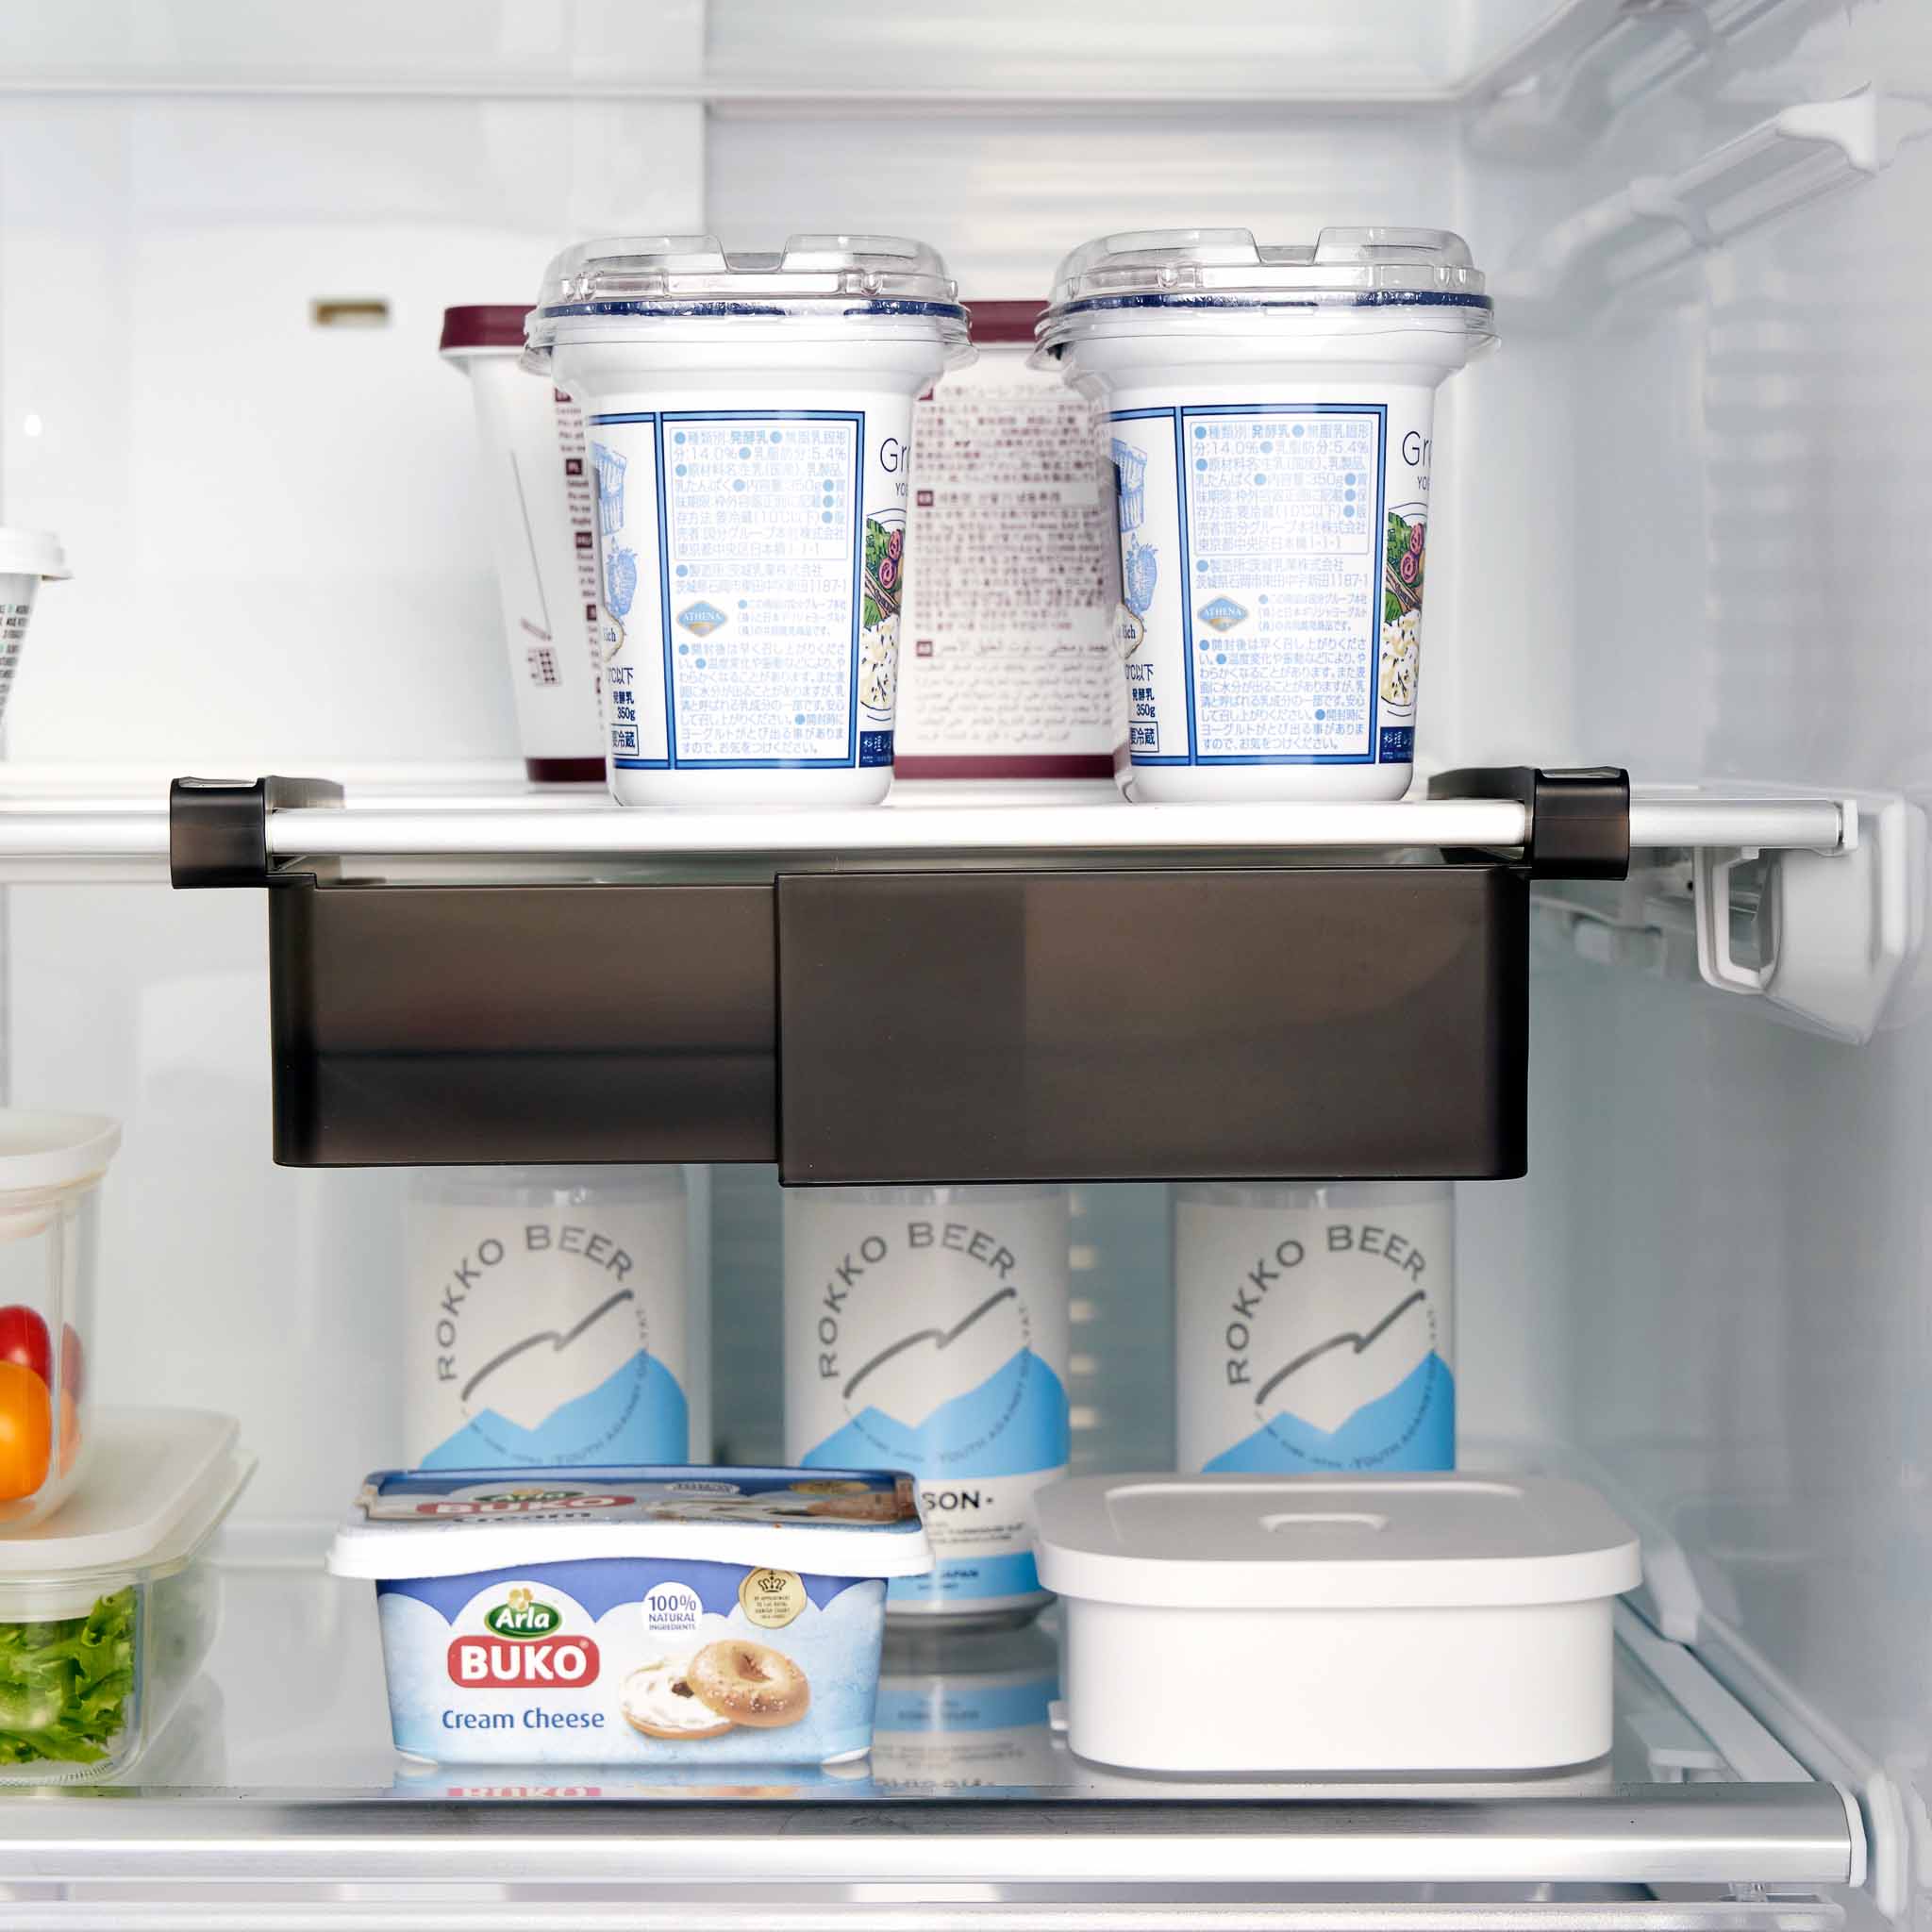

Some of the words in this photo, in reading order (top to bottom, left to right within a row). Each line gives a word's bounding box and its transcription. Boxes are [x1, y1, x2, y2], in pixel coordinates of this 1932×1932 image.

[879, 438, 909, 472] Gr
[1403, 430, 1432, 468] Gr
[684, 611, 723, 620] ATHENA
[617, 708, 636, 721] 350g
[1136, 704, 1156, 717] 350g
[436, 1239, 504, 1381] ROKKO
[525, 1224, 633, 1282] BEER
[818, 1236, 887, 1379] ROKKO
[908, 1222, 1016, 1278] BEER
[1226, 1240, 1305, 1386] ROKKO
[1326, 1224, 1426, 1282] BEER
[648, 1595, 696, 1611] 100%
[495, 1607, 550, 1629] Arla
[648, 1613, 695, 1623] NATURAL
[460, 1644, 587, 1680] BUKO
[441, 1709, 514, 1729] Cream
[523, 1707, 605, 1729] Cheese
